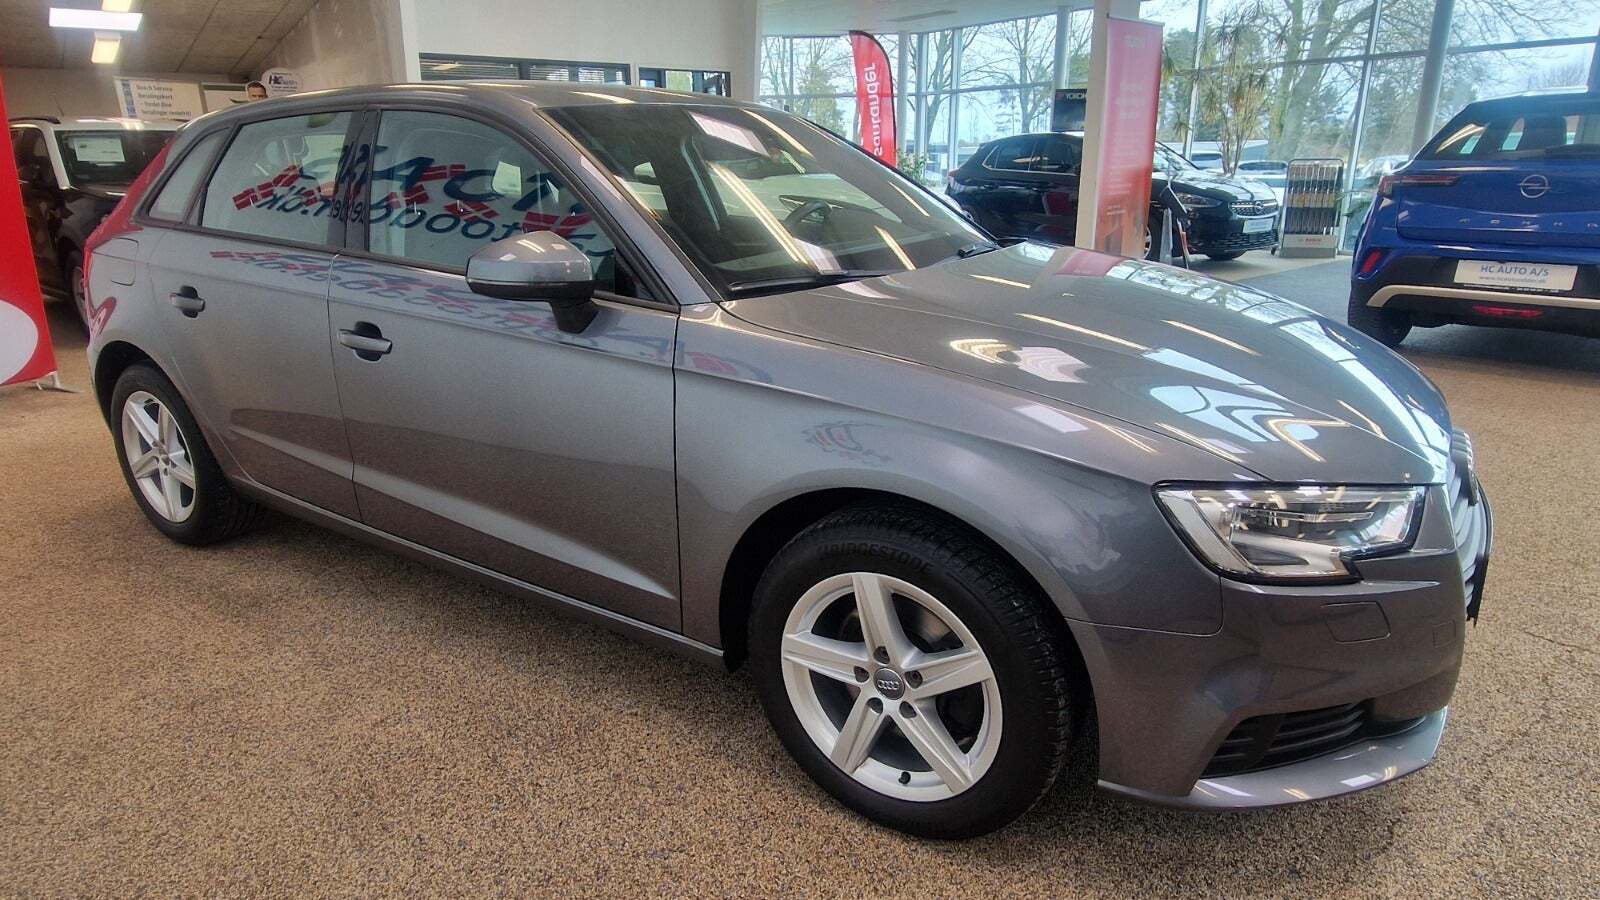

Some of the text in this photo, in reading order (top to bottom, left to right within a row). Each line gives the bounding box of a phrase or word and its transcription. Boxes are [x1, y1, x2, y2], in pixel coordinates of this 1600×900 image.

[1480, 264, 1550, 276] HC AUTO A/S
